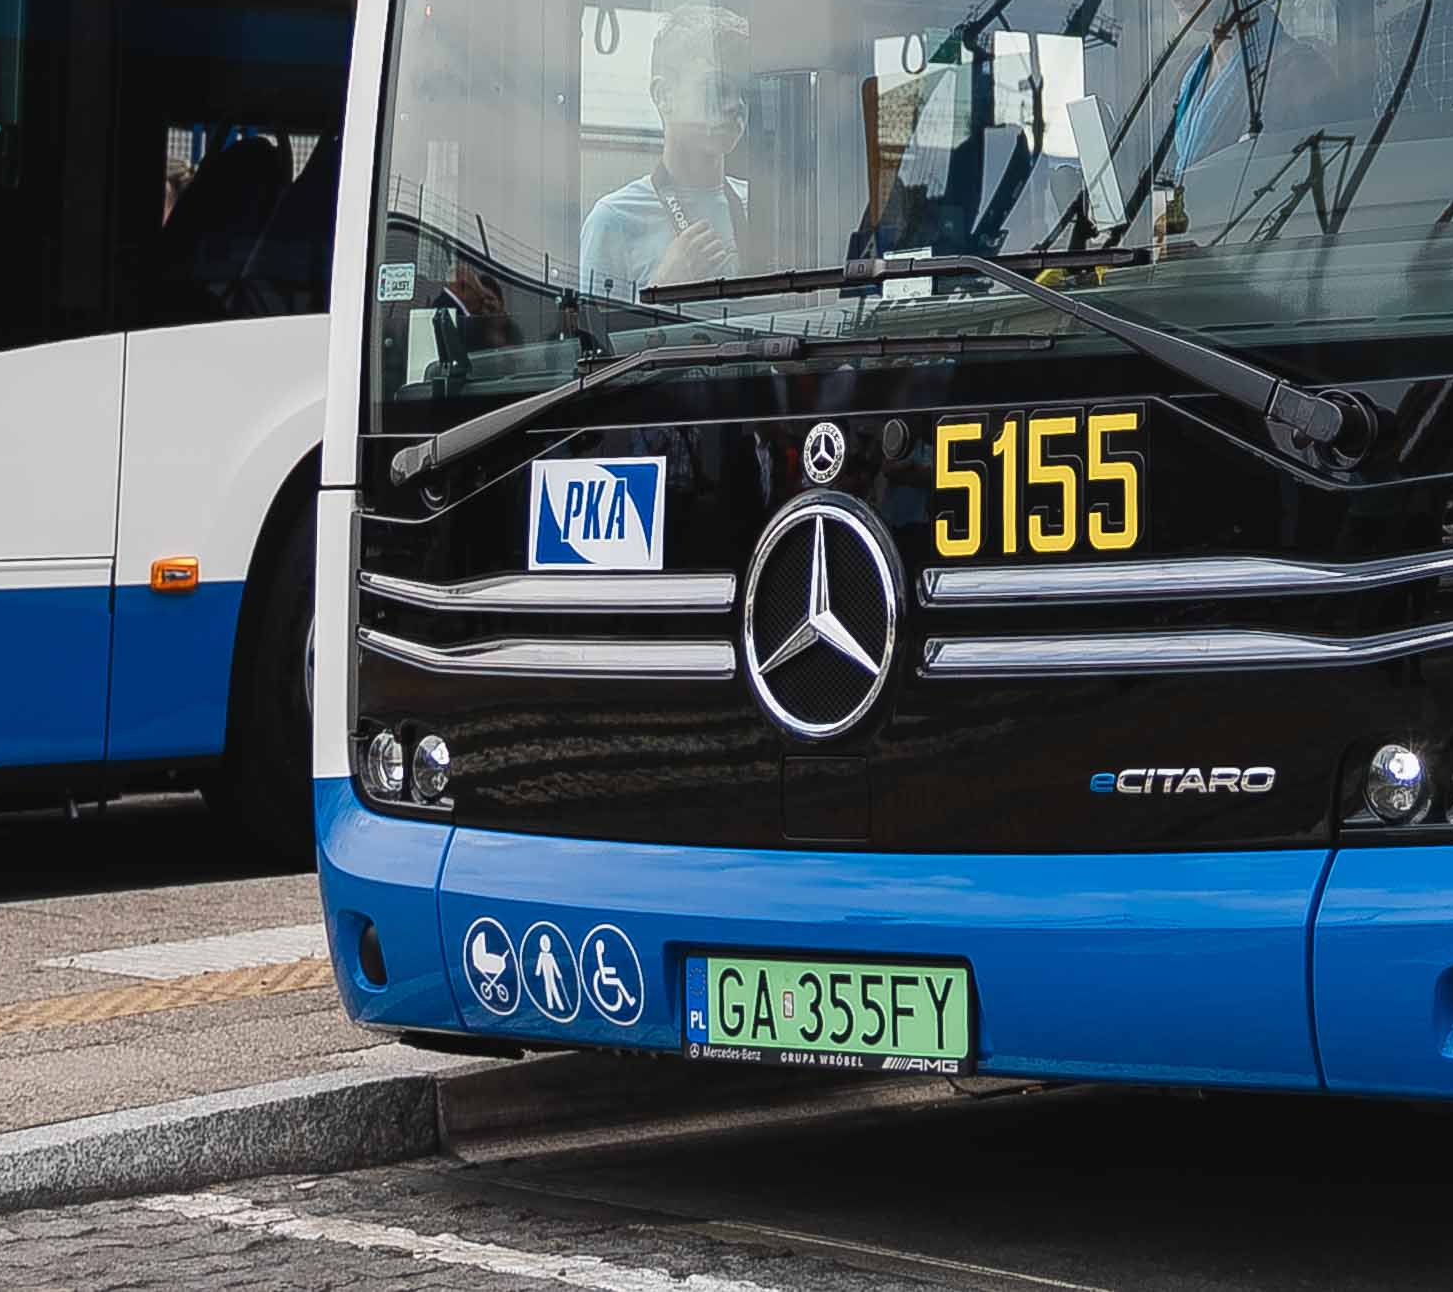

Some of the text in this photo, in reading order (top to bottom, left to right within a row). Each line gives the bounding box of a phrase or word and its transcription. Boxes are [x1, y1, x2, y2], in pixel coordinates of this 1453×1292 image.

[665, 195, 690, 231] SONY
[935, 413, 1139, 557] 5155
[561, 479, 627, 541] PKA
[1089, 766, 1277, 794] eCITARO
[690, 1011, 706, 1030] PL
[718, 967, 954, 1050] GA 355FY
[702, 1045, 761, 1061] Mercedes-Benz
[780, 1051, 864, 1067] GRUPA WRÓBEL
